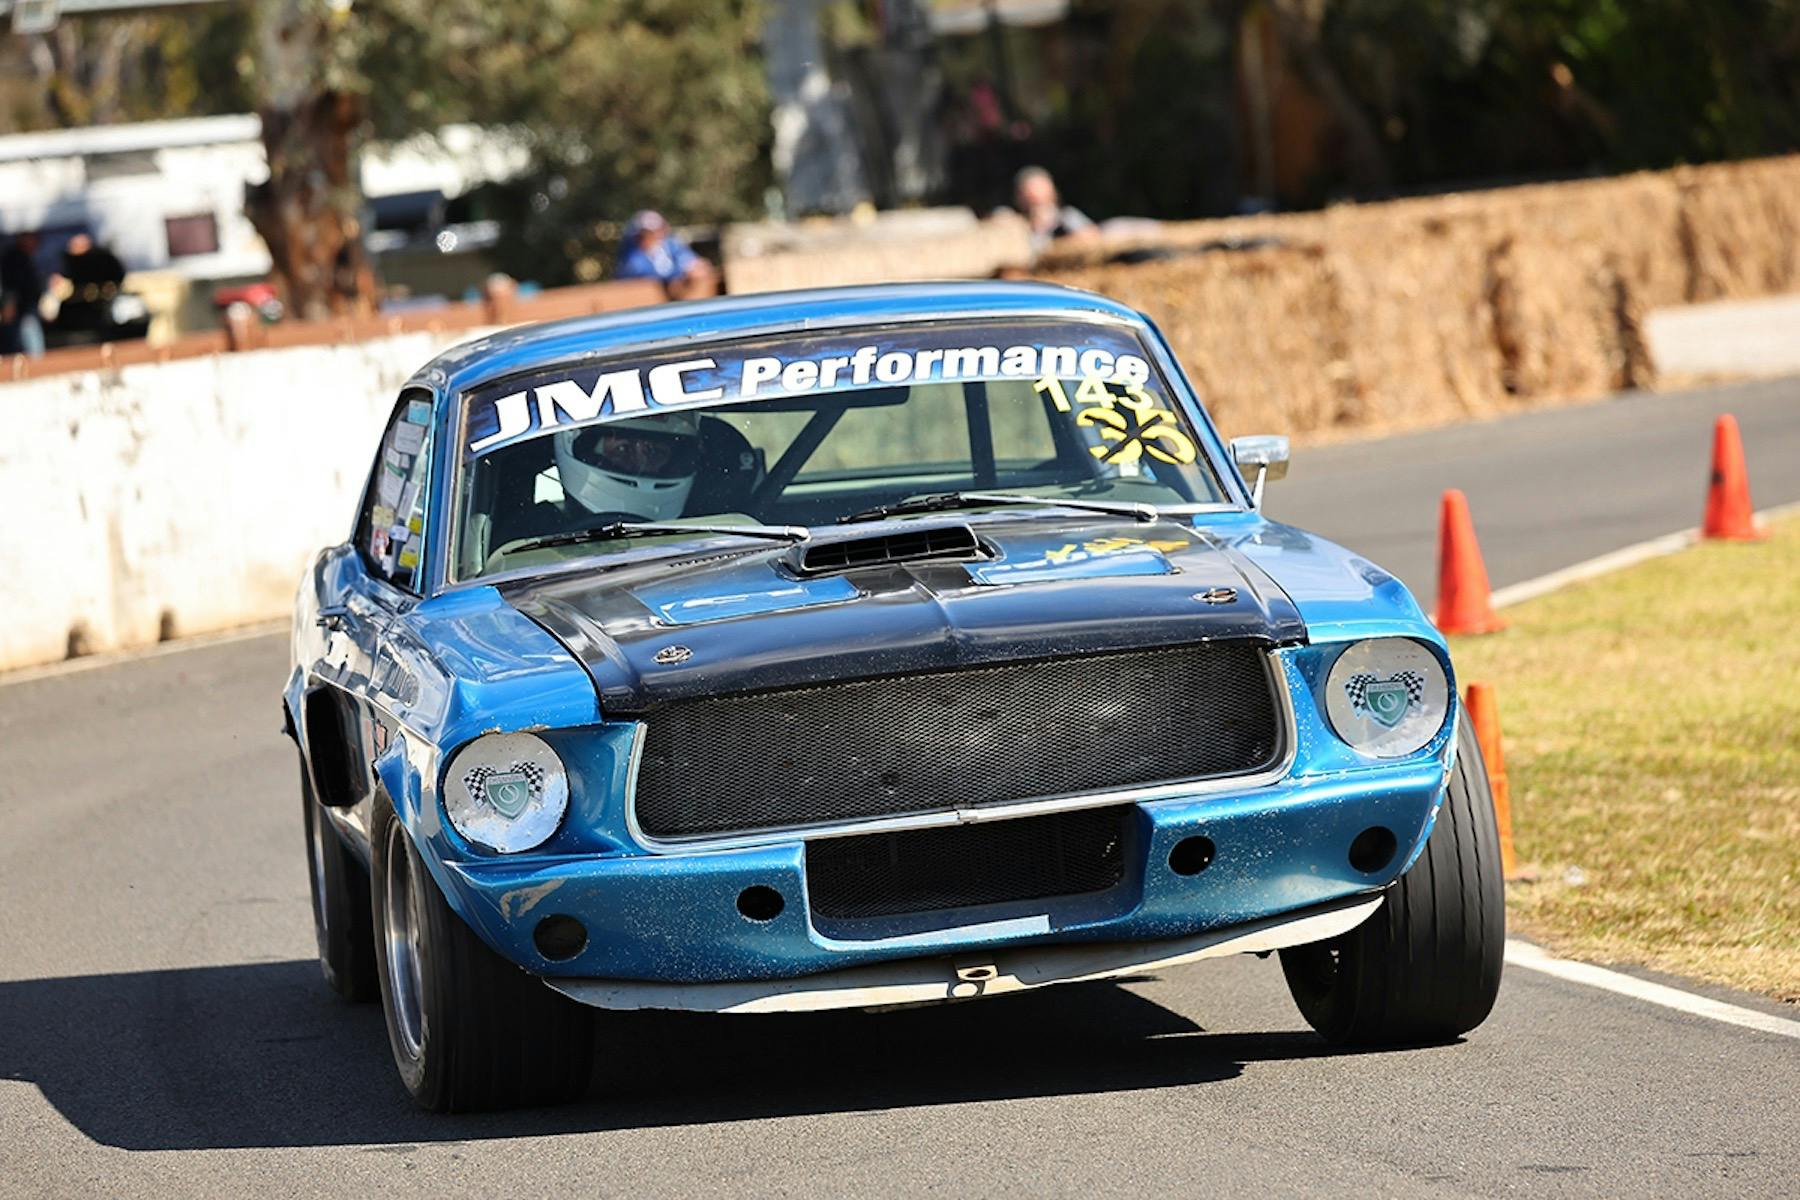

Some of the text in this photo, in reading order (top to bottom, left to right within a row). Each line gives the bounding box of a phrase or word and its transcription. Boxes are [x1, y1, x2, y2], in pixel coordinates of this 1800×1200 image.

[470, 345, 1150, 453] JMC Performance
[1033, 374, 1154, 413] 143
